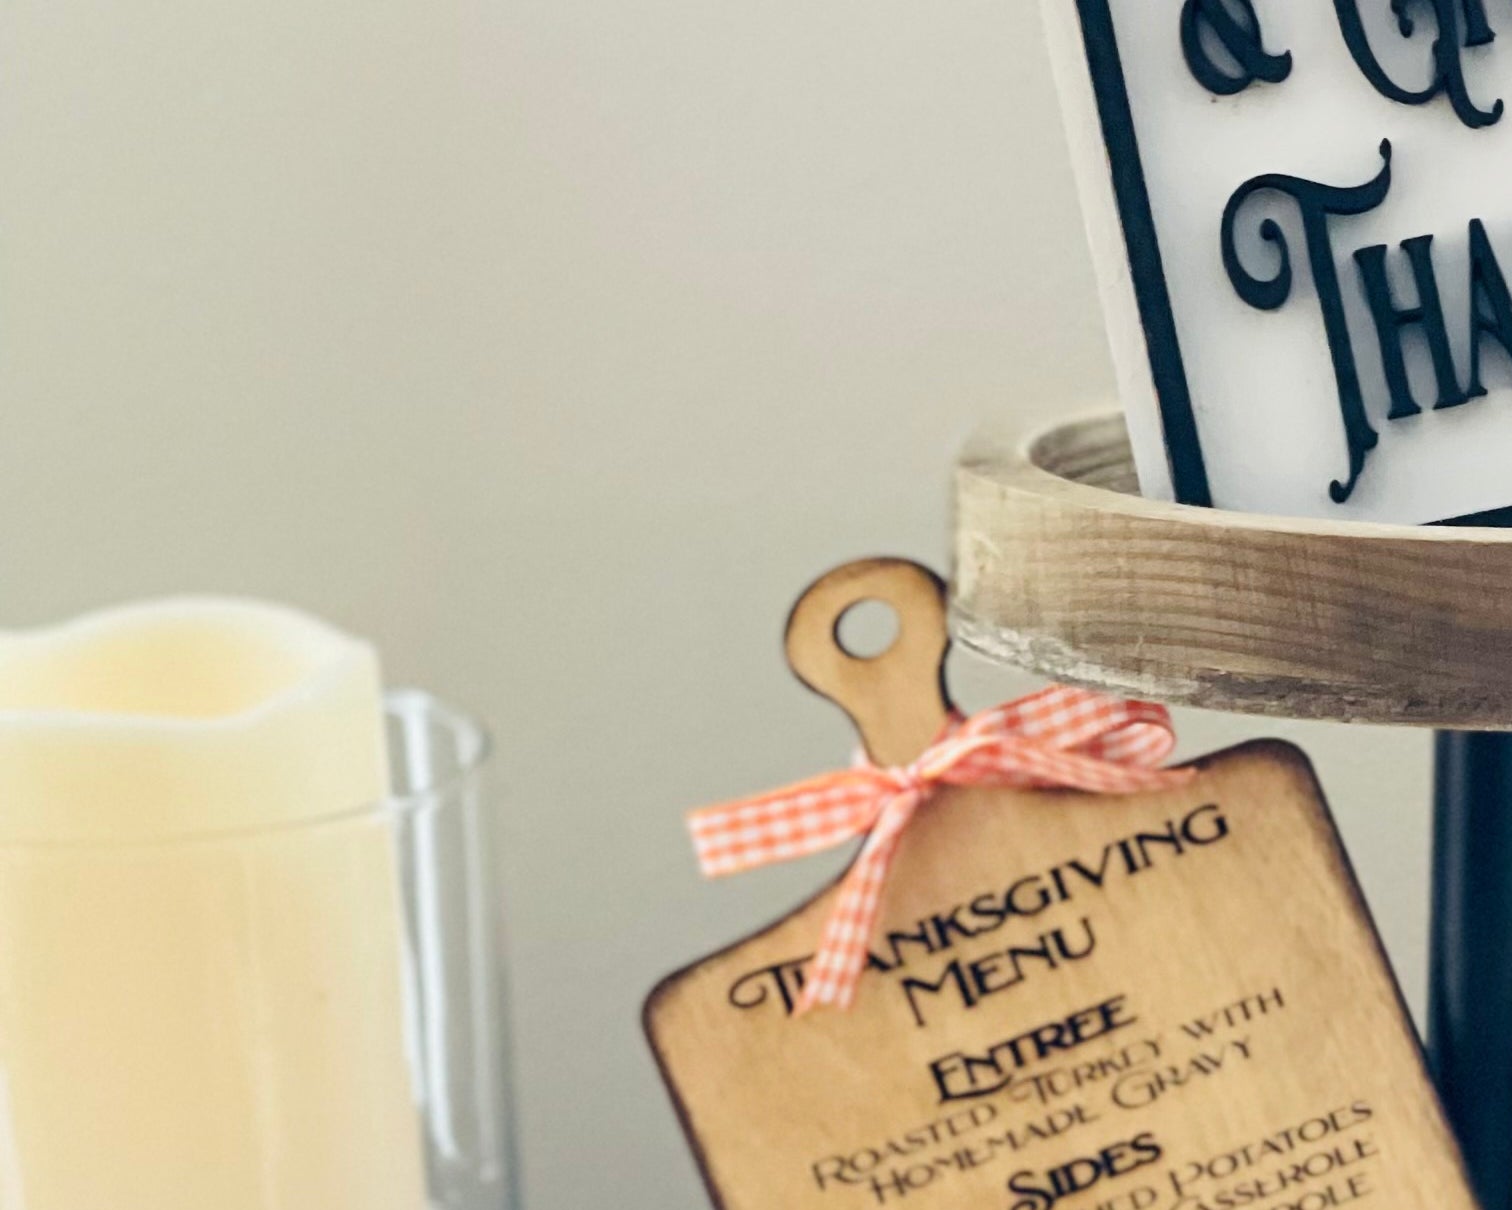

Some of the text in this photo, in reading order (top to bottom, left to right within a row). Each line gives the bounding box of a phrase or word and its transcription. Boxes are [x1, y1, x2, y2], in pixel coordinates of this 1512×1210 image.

[729, 804, 1230, 1016] TNKSGIVING
[901, 917, 1095, 1027] MENU
[810, 986, 1286, 1193] ROASTED TURKEY WITH
[929, 994, 1138, 1103] ENTREE
[869, 1037, 1253, 1205] HOMEMADE GRAVY
[1169, 1100, 1373, 1198] POTATOES
